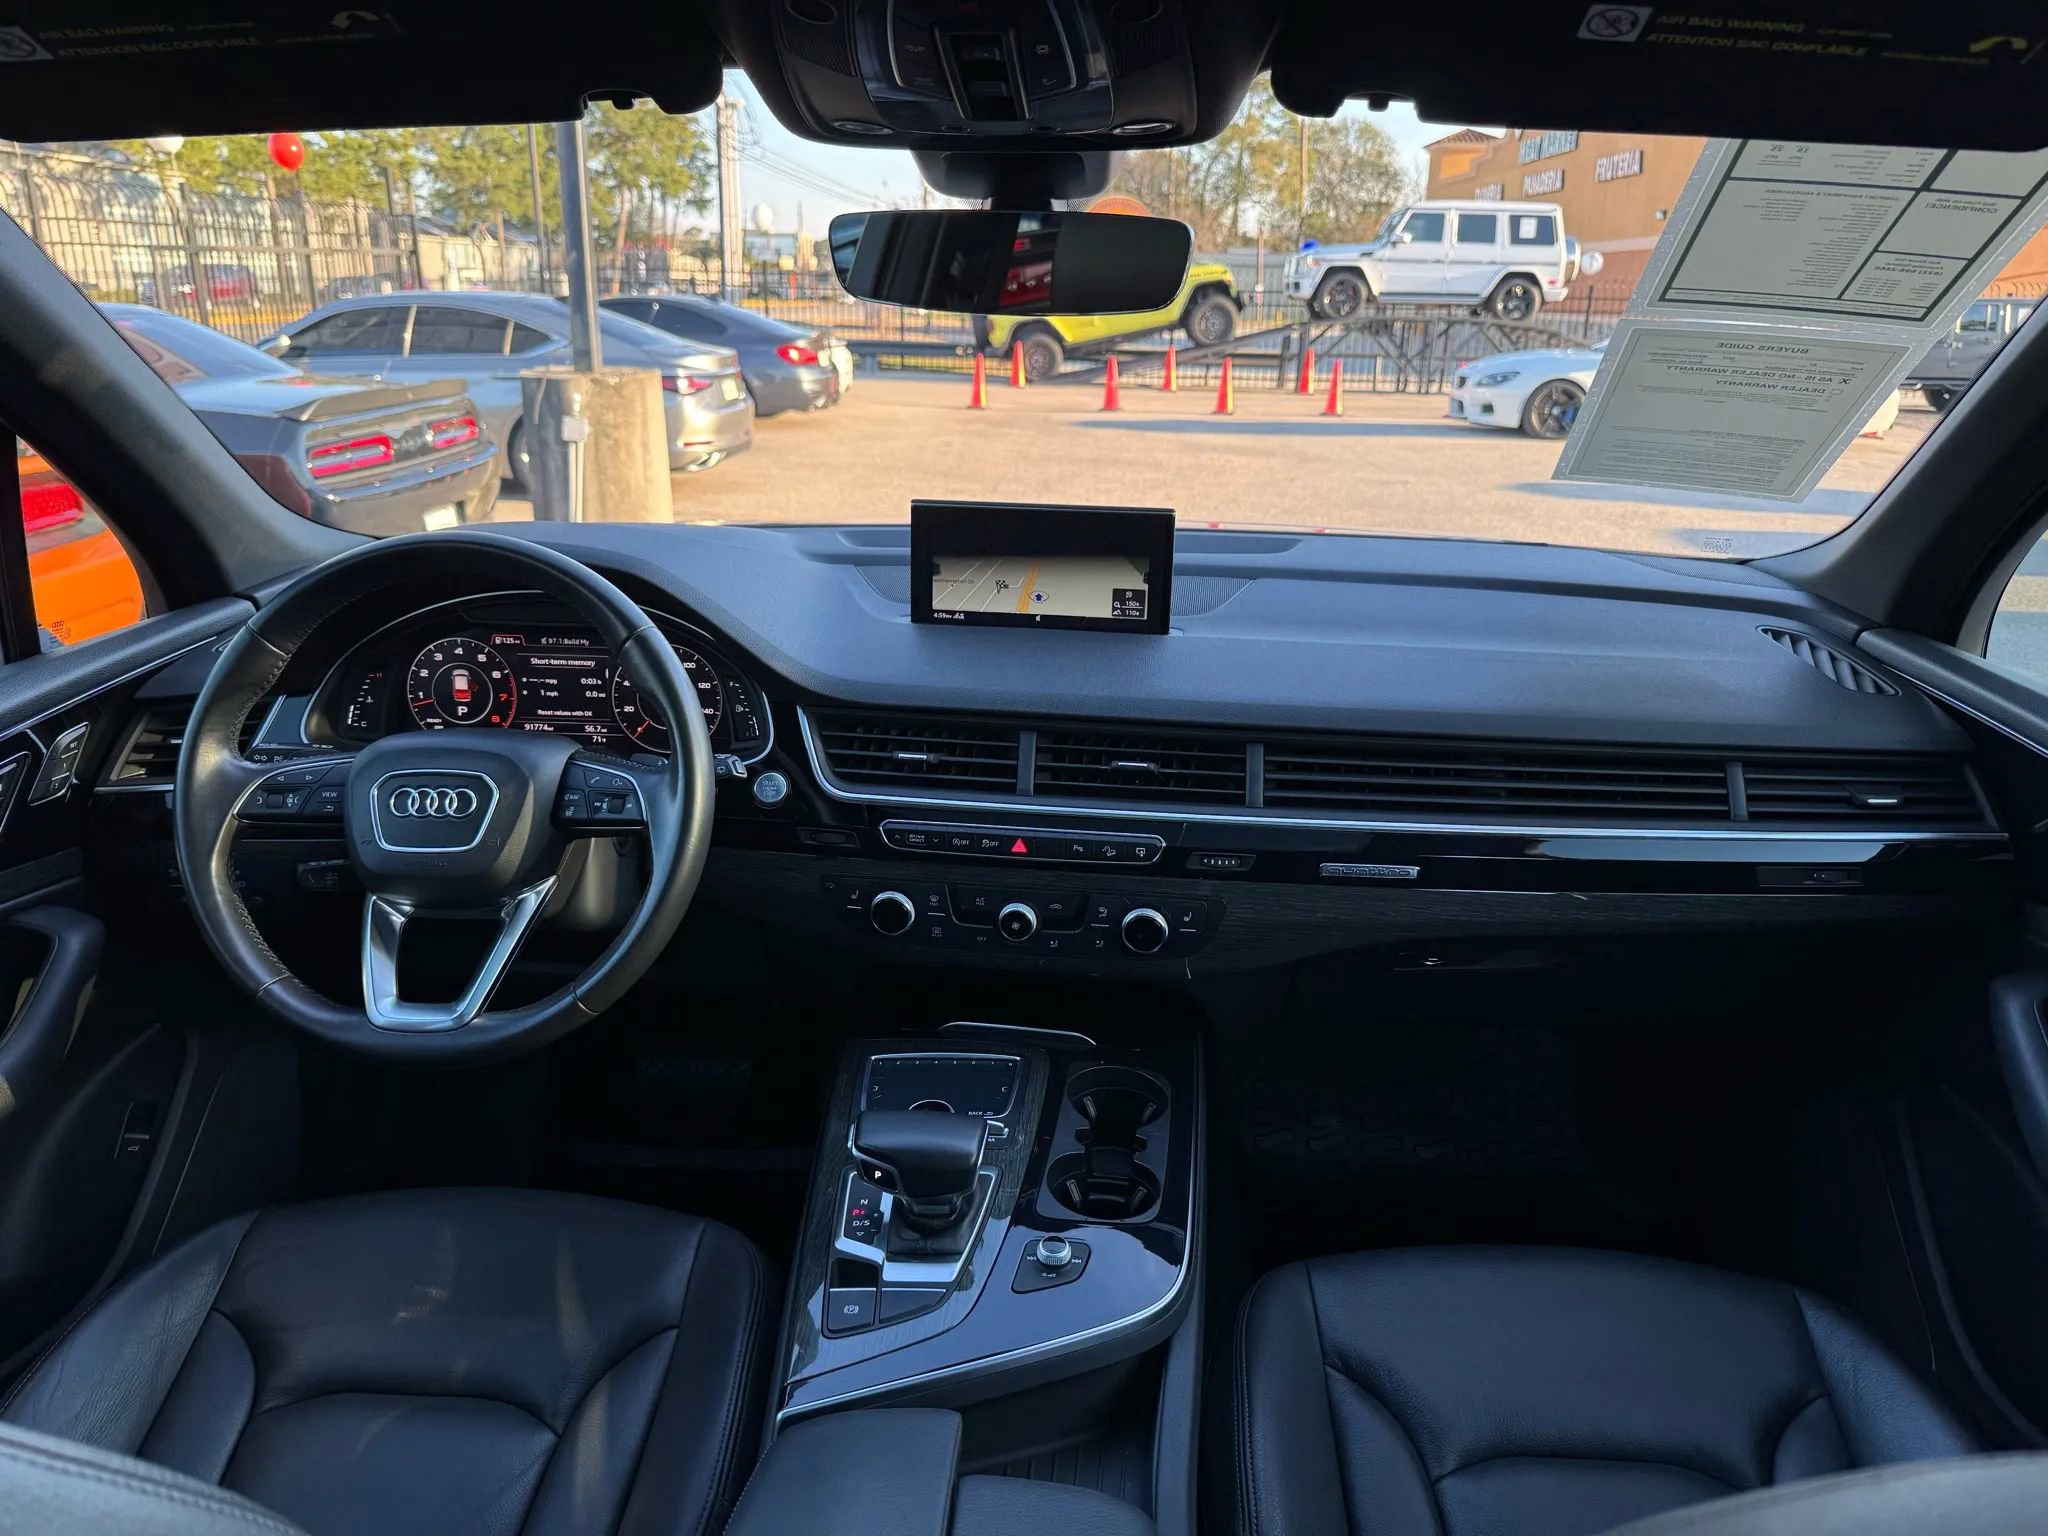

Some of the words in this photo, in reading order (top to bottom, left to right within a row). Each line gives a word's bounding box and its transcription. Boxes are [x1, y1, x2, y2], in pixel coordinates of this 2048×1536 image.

[1657, 15, 1684, 25] AIR
[1688, 17, 1722, 28] BAG
[1725, 19, 1806, 33] WARNING
[1646, 33, 1734, 48] ATTENTION
[1737, 38, 1770, 50] SAC
[1772, 41, 1867, 57] GONFLABLE
[1595, 149, 1643, 183] FRUTERIA
[1523, 168, 1565, 197] PANADERIA
[454, 647, 464, 655] 4
[434, 653, 443, 661] 3
[477, 654, 487, 662] 5
[530, 657, 568, 665] Short-term
[568, 659, 596, 668] memory
[420, 669, 430, 677] 2
[491, 671, 502, 679] 6
[499, 694, 509, 702] 7
[457, 706, 468, 716] P
[623, 705, 635, 713] 20
[491, 715, 500, 723] 8
[1327, 866, 1413, 877] quattro
[874, 1170, 882, 1179] P
[852, 1219, 871, 1227] D/S
